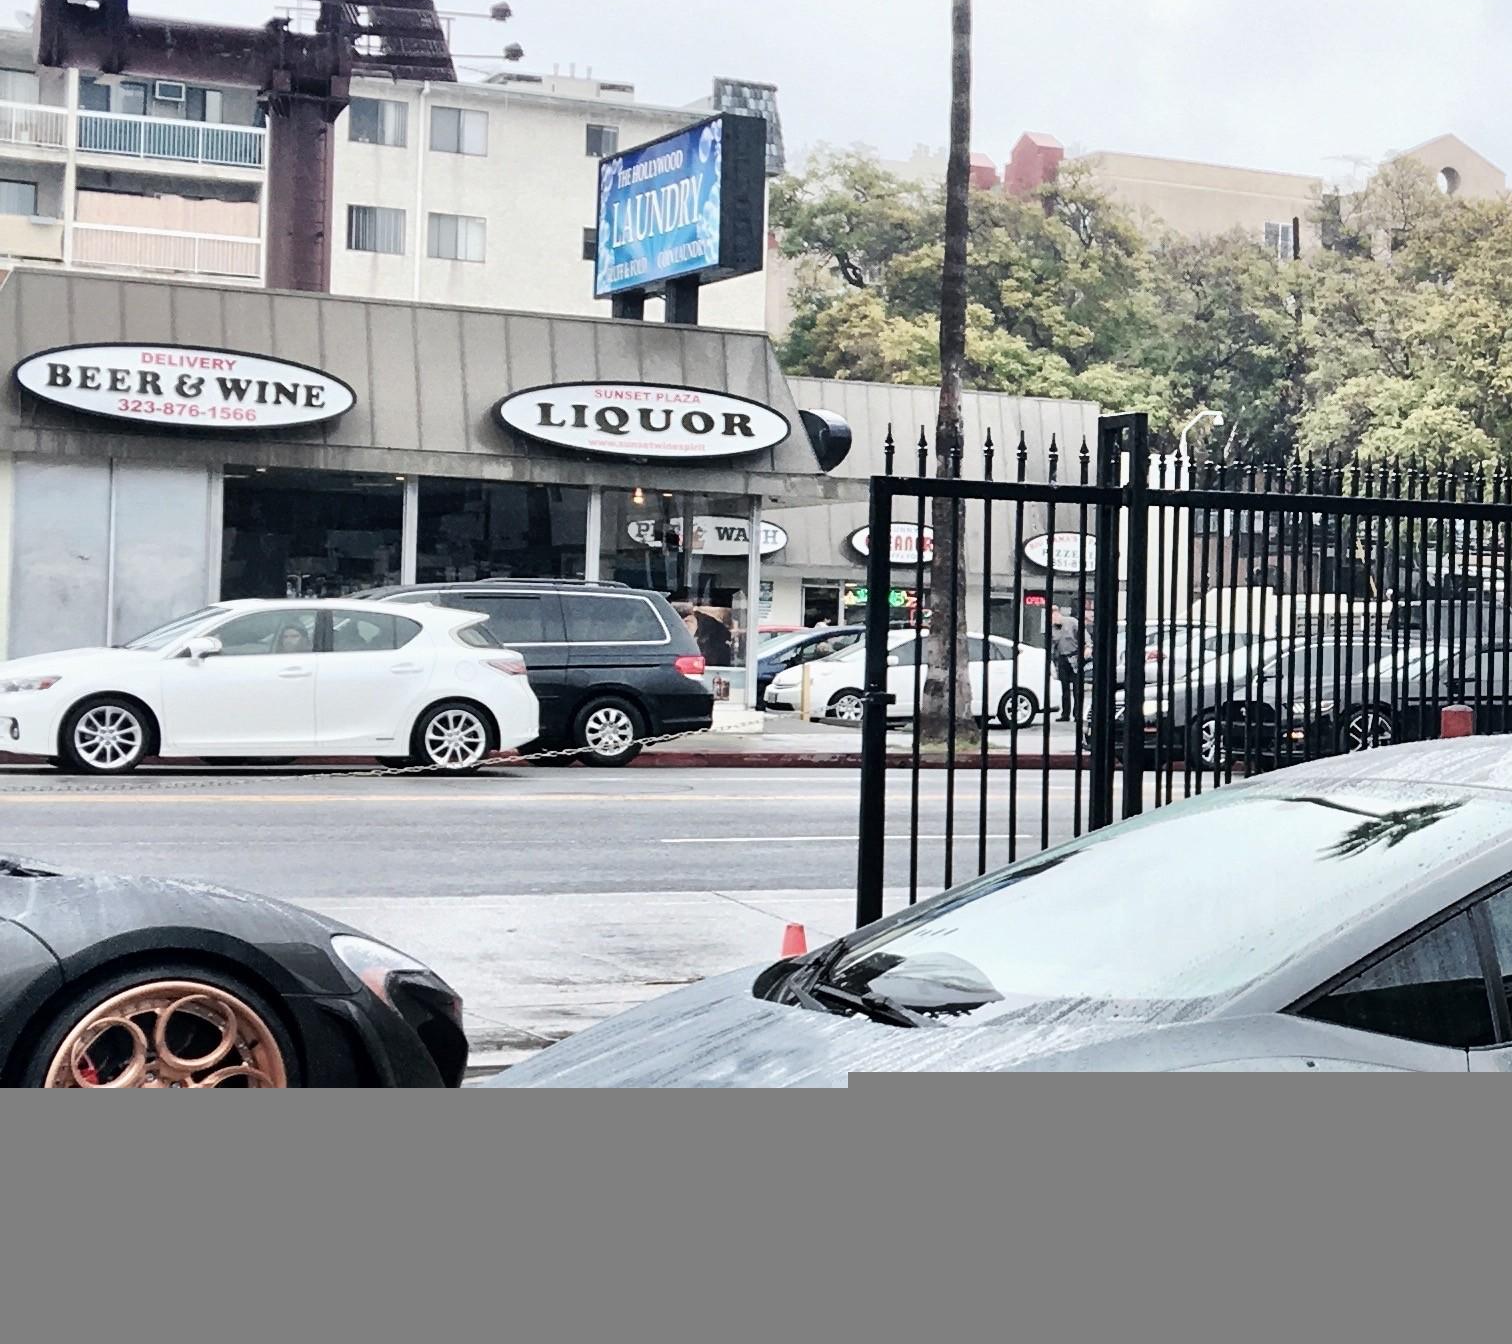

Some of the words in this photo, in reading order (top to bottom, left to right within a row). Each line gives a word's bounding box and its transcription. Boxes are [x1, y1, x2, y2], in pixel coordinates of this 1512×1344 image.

[632, 150, 684, 184] HOLLYWOOD
[612, 173, 704, 248] LAUNDRY
[141, 351, 238, 371] DELIVERY
[46, 363, 164, 396] BEER
[175, 373, 206, 399] &
[216, 376, 327, 409] WINE
[594, 388, 651, 402] SUNSET
[657, 391, 702, 404] PLAZA
[118, 398, 258, 422] 323-876-1566
[536, 402, 756, 437] LIQUOR
[715, 526, 779, 545] WAH
